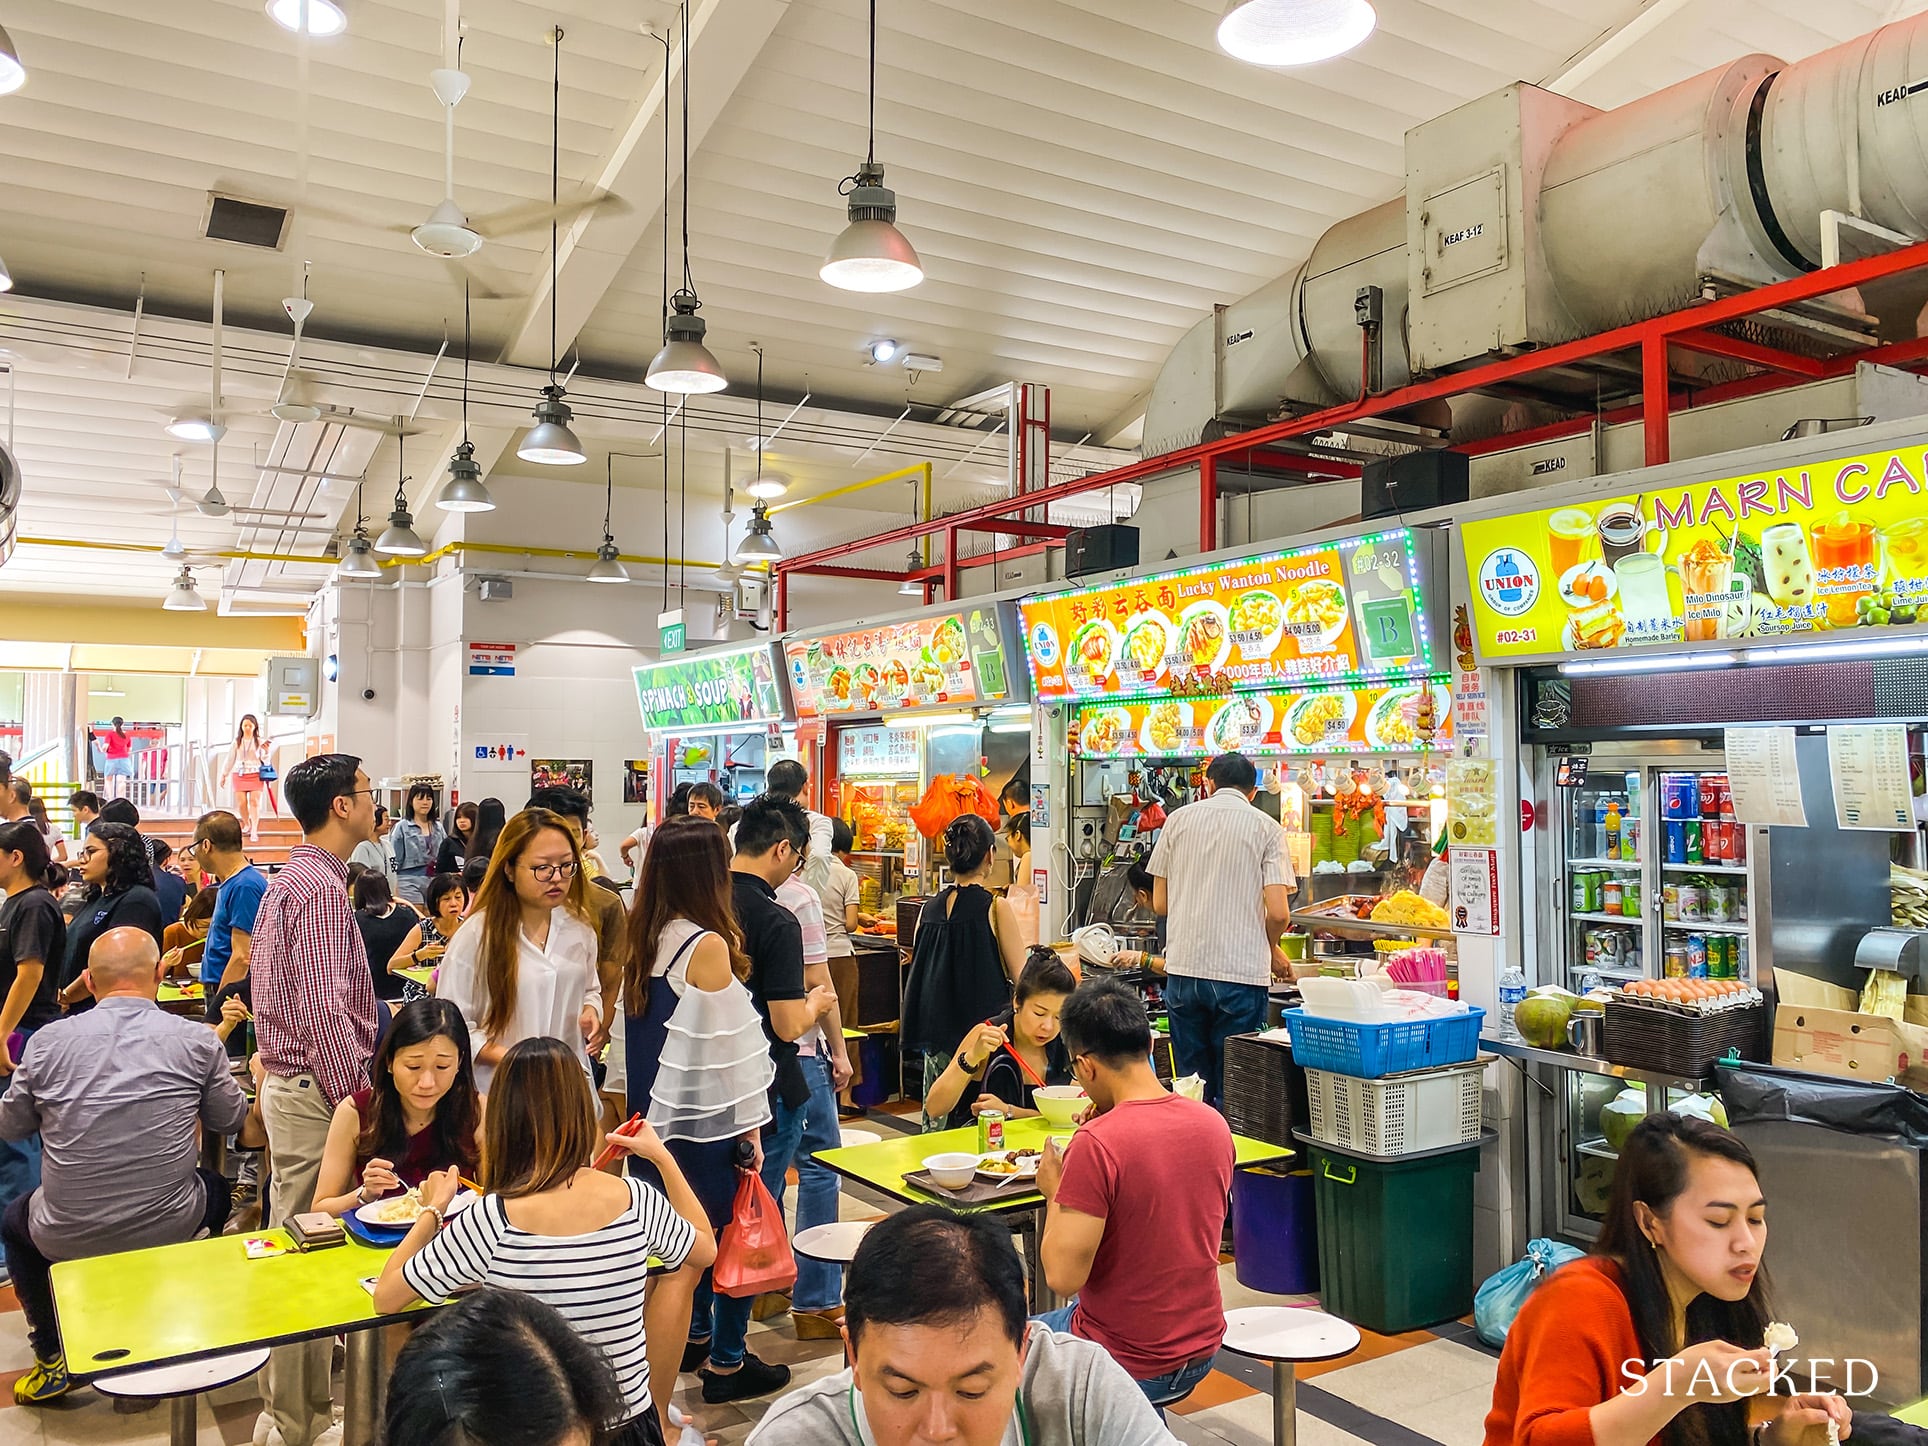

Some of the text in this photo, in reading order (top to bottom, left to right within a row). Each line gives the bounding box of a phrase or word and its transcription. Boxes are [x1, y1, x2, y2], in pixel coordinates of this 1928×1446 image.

[1877, 85, 1907, 107] KEAD
[1444, 224, 1483, 247] KEAF 3-12
[1545, 457, 1566, 472] KEAD
[1653, 472, 1813, 530] MARN
[1356, 550, 1401, 571] #02-32
[1177, 560, 1331, 598] Lucky Wanton Noodle
[1485, 575, 1534, 591] UNION
[1291, 589, 1297, 599] 5
[1817, 582, 1873, 595] Ice Lemon Tea
[1234, 597, 1240, 606] 4
[1686, 594, 1704, 604] Milo
[1706, 591, 1744, 601] Dinosaur
[1892, 597, 1913, 605] Lime
[1070, 585, 1175, 625] 好彩云吞面
[1175, 615, 1181, 624] 3
[1688, 608, 1721, 619] Ice Milo
[1378, 616, 1398, 642] B
[1760, 620, 1812, 633] Soursop Juice
[667, 629, 682, 649] EXIT
[1497, 629, 1537, 644] #02-31
[1625, 632, 1681, 642] Homemade Barley
[1034, 639, 1055, 650] UNION
[986, 663, 995, 682] B
[686, 683, 695, 705] &
[694, 677, 728, 707] SOUP
[1461, 683, 1480, 693] 服务
[1283, 699, 1288, 707] 9
[1369, 693, 1377, 702] 10
